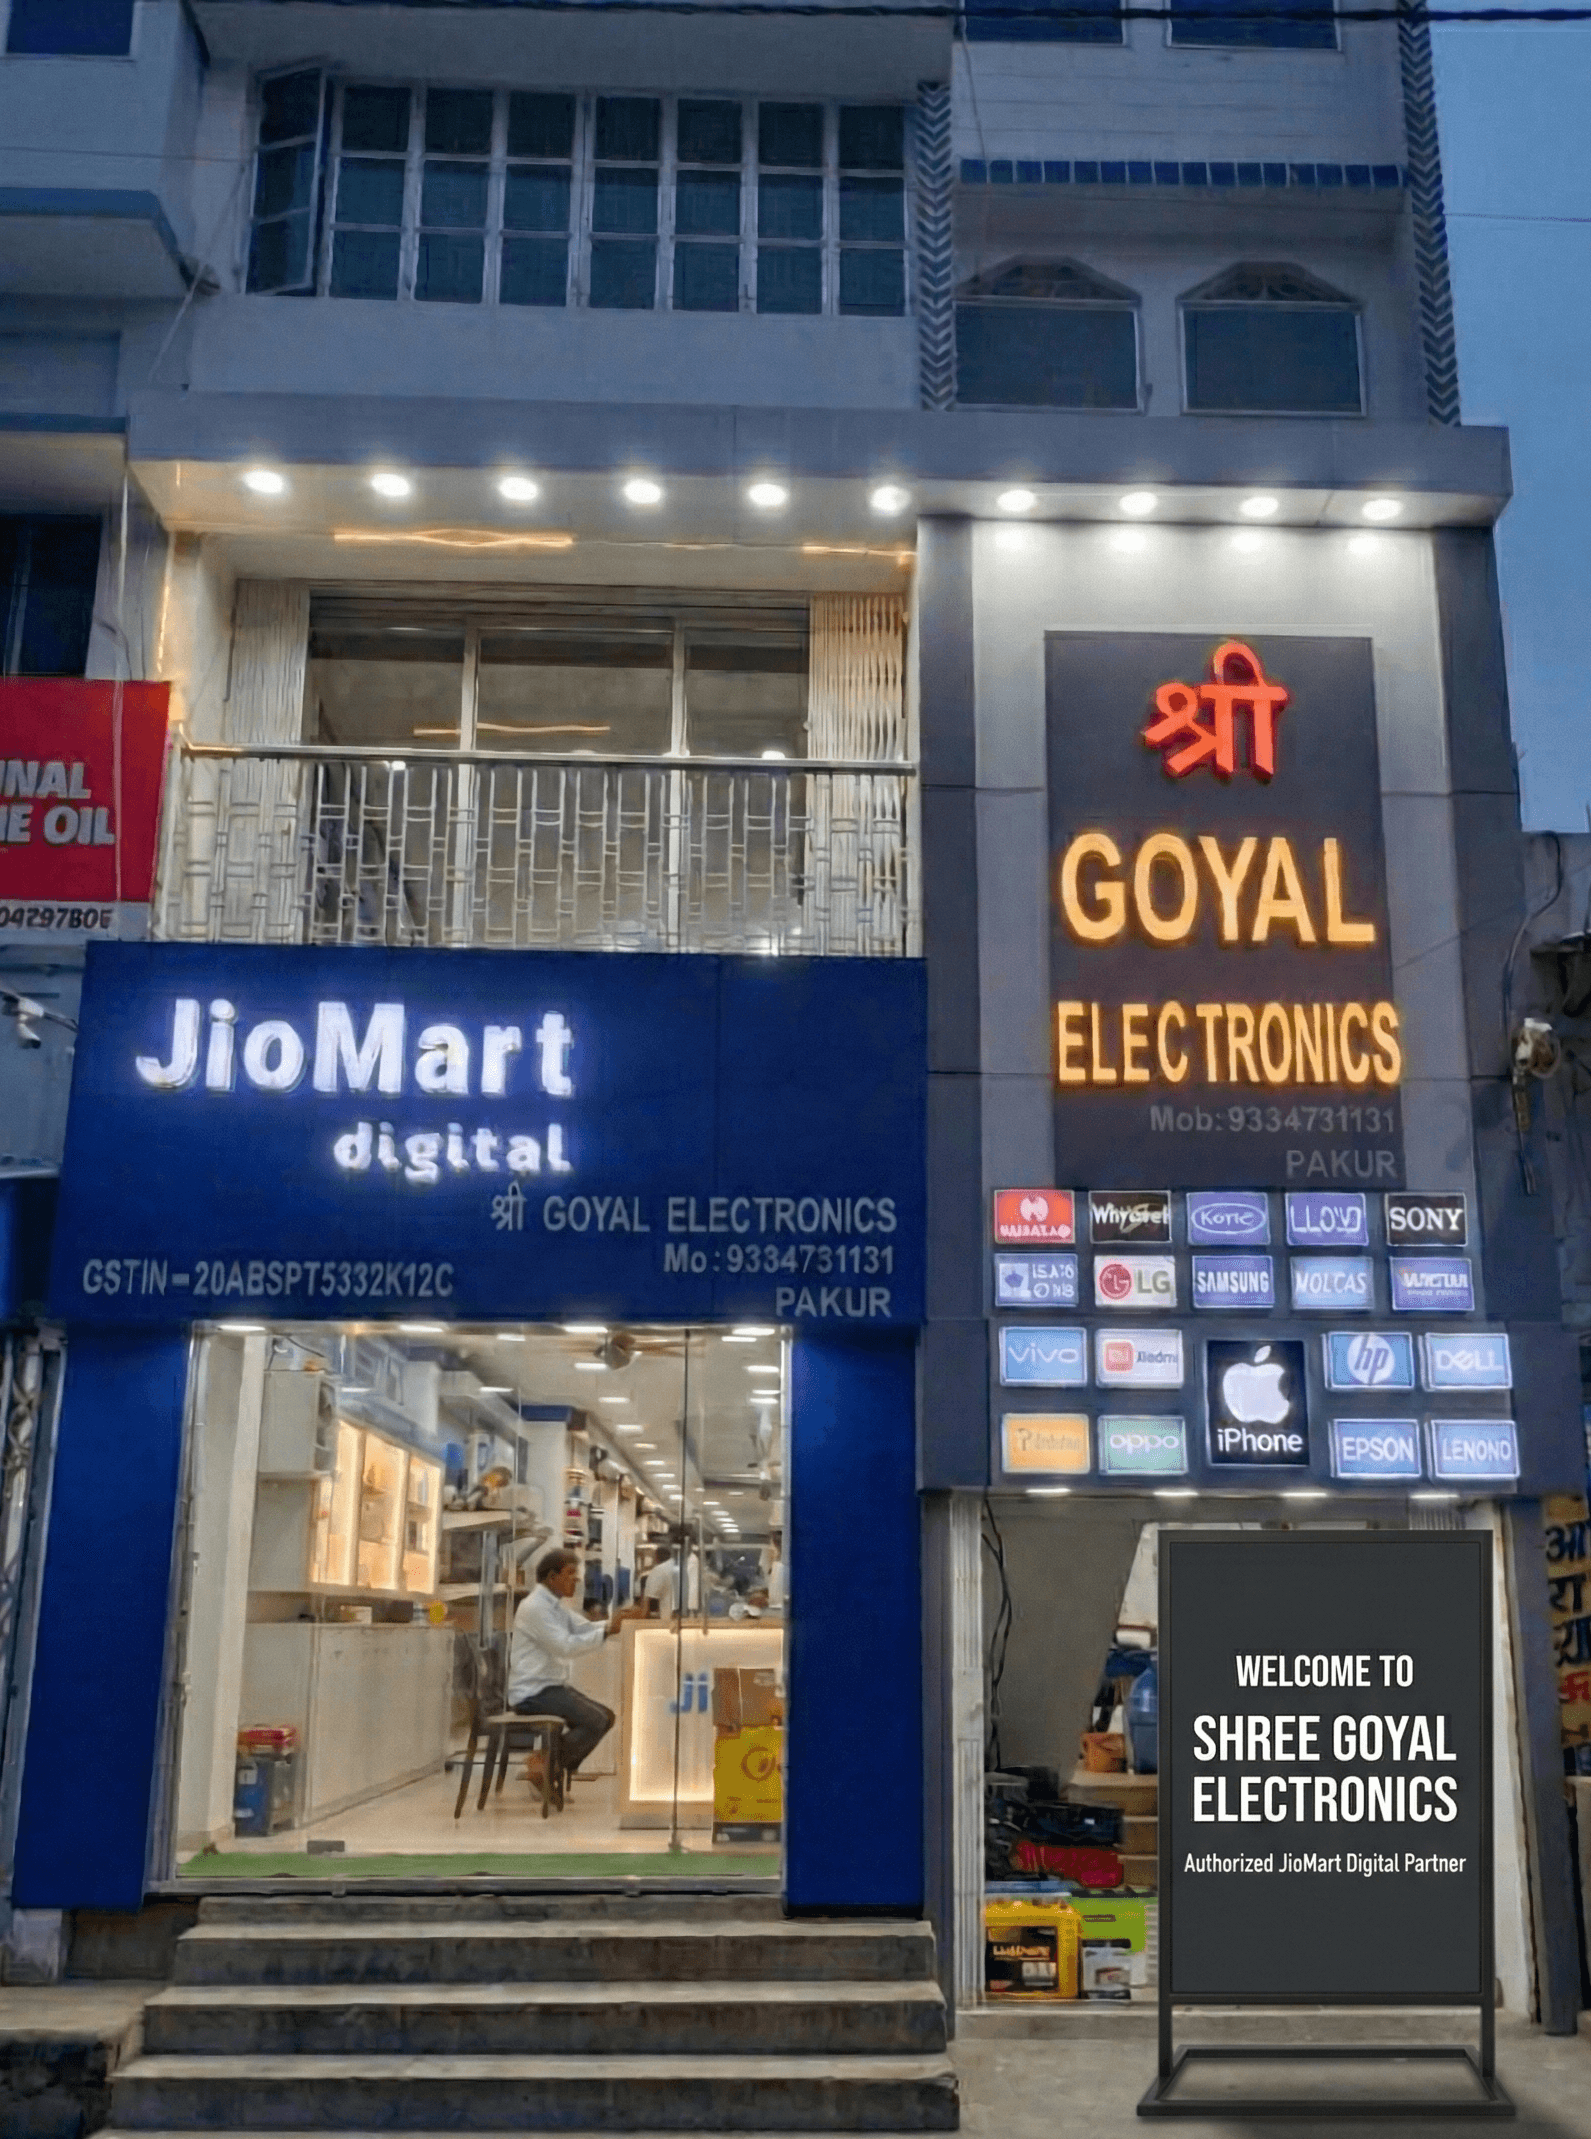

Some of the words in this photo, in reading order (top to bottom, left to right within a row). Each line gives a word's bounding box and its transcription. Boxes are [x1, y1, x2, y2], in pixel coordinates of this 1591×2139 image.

[1143, 639, 1289, 783] श्री
[44, 805, 117, 845] OIL
[1061, 833, 1376, 945] GOYAL
[136, 999, 574, 1097] JioMart
[1057, 1001, 1402, 1085] ELECTRONICS
[334, 1121, 572, 1185] digital
[1286, 1150, 1398, 1178] PAKUR
[490, 1180, 526, 1232] श्री
[543, 1196, 651, 1233] GOYAL
[667, 1197, 898, 1234] ELECTRONICS
[1389, 1206, 1464, 1231] SONY
[1136, 1270, 1172, 1294] LG
[1197, 1271, 1270, 1293] SAMSUNG
[775, 1287, 892, 1317] PAKUR
[1008, 1342, 1080, 1363] vivo
[1354, 1334, 1390, 1384] hp
[1435, 1350, 1505, 1372] DELL
[1110, 1434, 1179, 1454] oppo
[1217, 1427, 1303, 1452] iPhone
[1342, 1436, 1415, 1462] EPSON
[1236, 1655, 1371, 1687] WELCOME
[1379, 1655, 1413, 1687] TO
[1193, 1715, 1320, 1761] SHREE
[1333, 1715, 1457, 1761] GOYAL
[1193, 1776, 1458, 1822] ELECTRONICS
[1184, 1853, 1273, 1873] Authorized
[1279, 1853, 1342, 1873] JioMart
[1346, 1853, 1400, 1878] Digital
[1404, 1853, 1467, 1873] Partner
